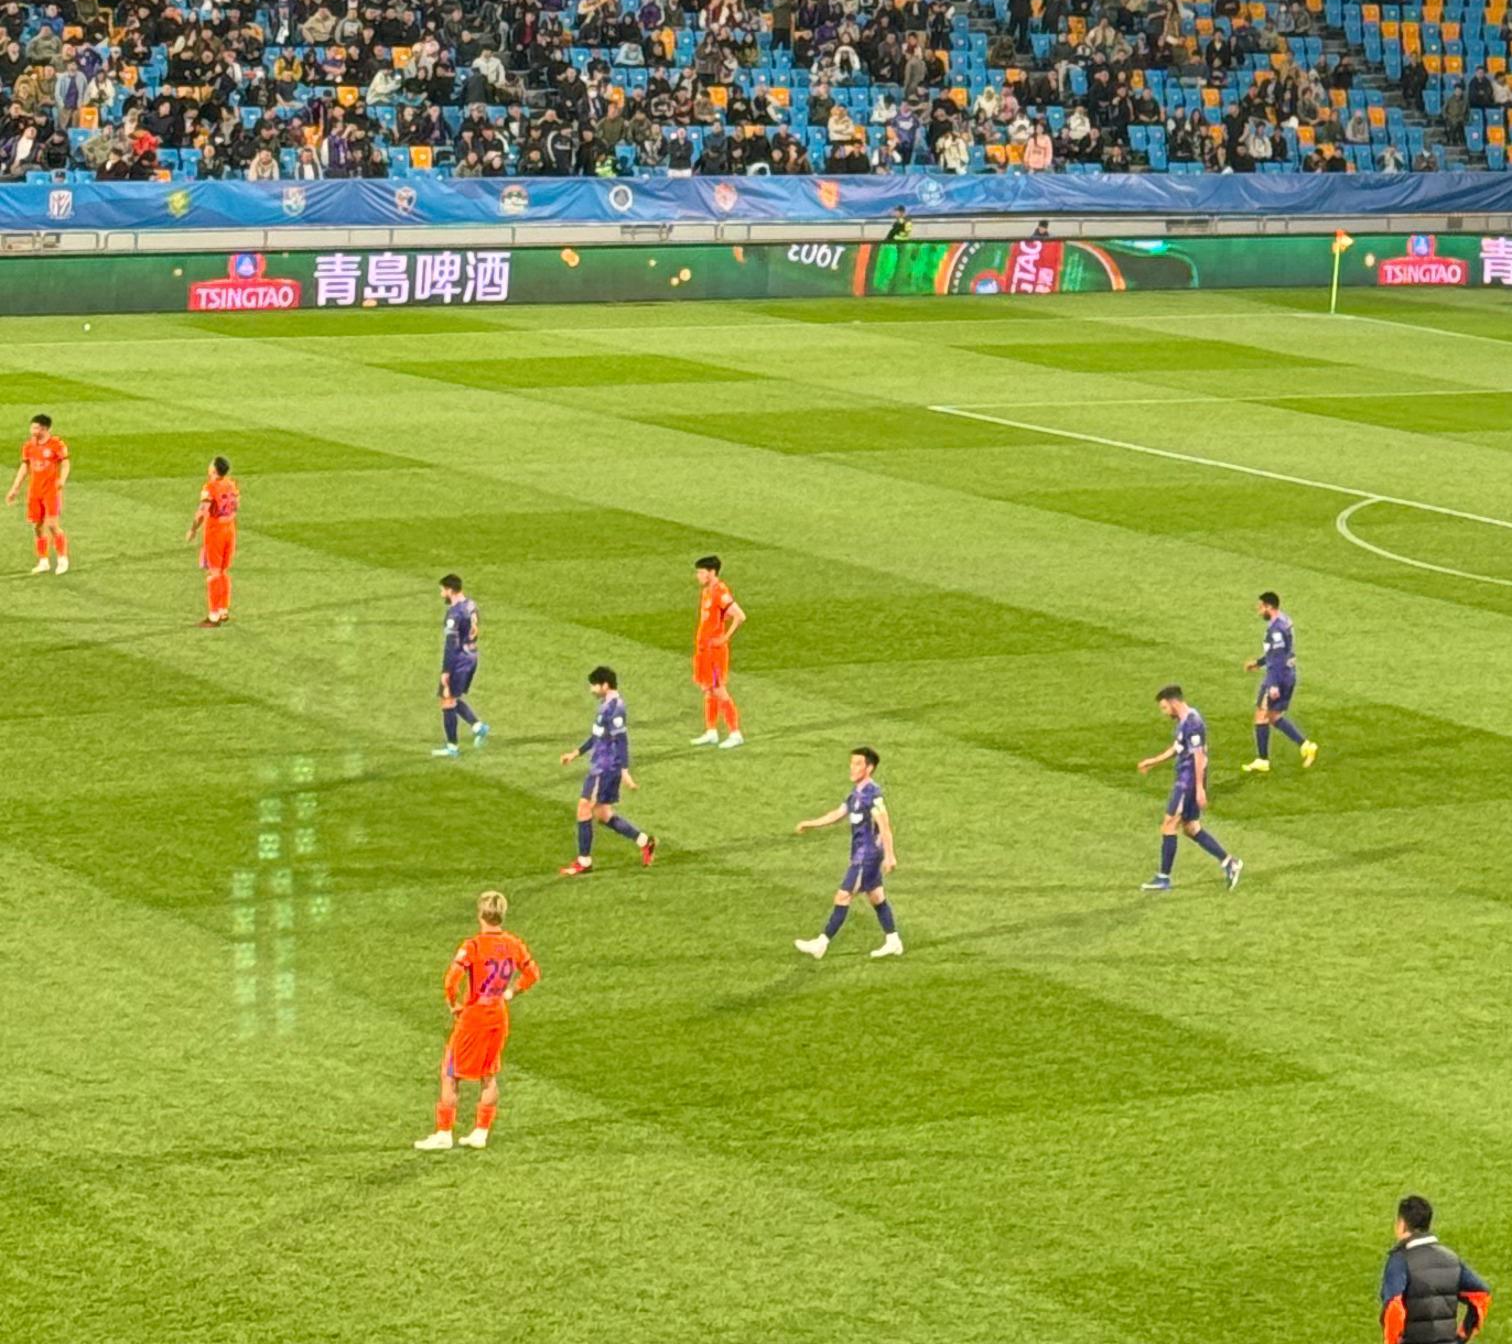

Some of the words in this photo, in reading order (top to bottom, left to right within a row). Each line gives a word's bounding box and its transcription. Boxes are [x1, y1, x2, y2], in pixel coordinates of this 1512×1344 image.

[314, 251, 511, 307] 青島啤酒
[1384, 263, 1462, 284] TSINGTAO
[196, 286, 294, 309] TSINGTAO
